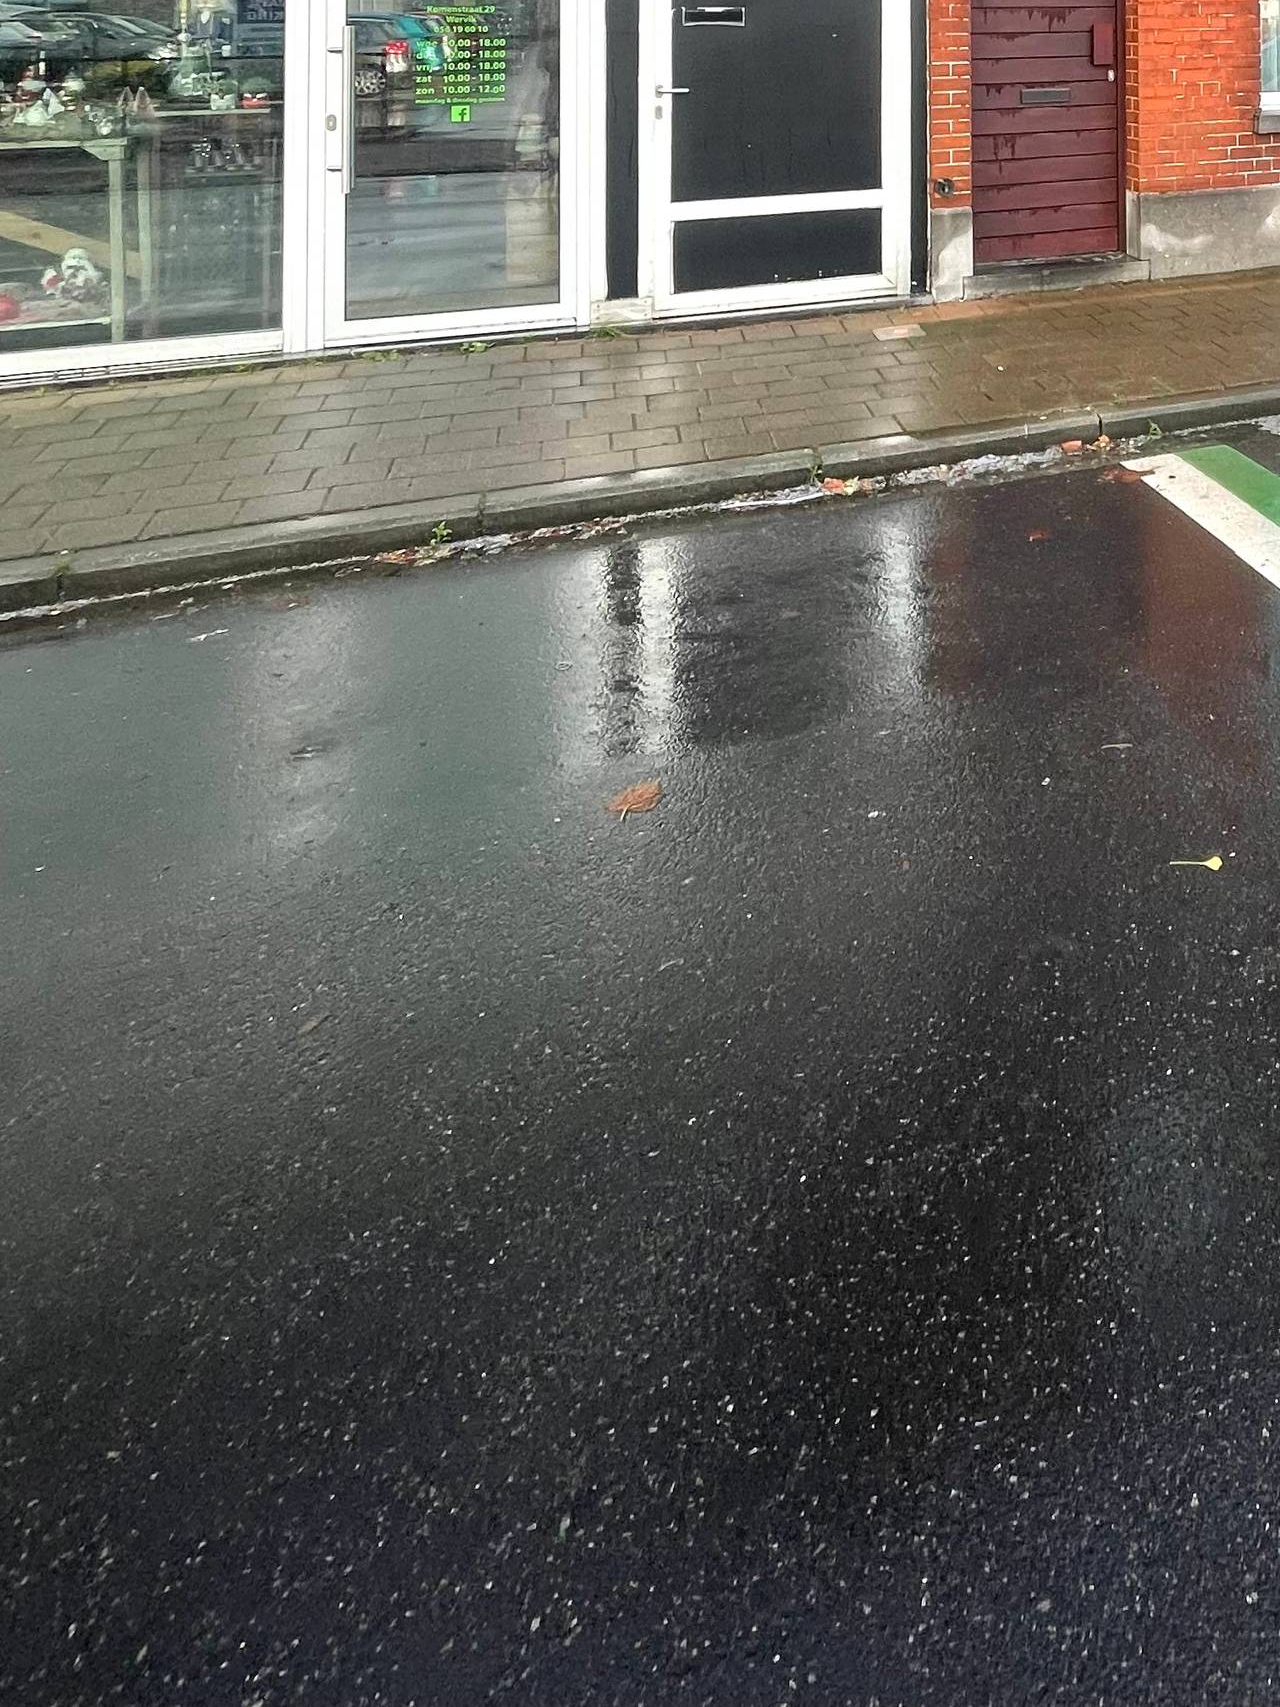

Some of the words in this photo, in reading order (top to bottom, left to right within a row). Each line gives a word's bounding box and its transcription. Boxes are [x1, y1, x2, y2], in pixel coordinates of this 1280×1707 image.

[478, 25, 489, 33] 10
[479, 38, 507, 47] 18.00
[479, 50, 506, 59] 18.00
[443, 62, 471, 71] 10.00
[479, 61, 506, 70] 18.00
[415, 74, 432, 83] zat
[443, 74, 471, 83] 10.00
[443, 85, 471, 94] 10.00
